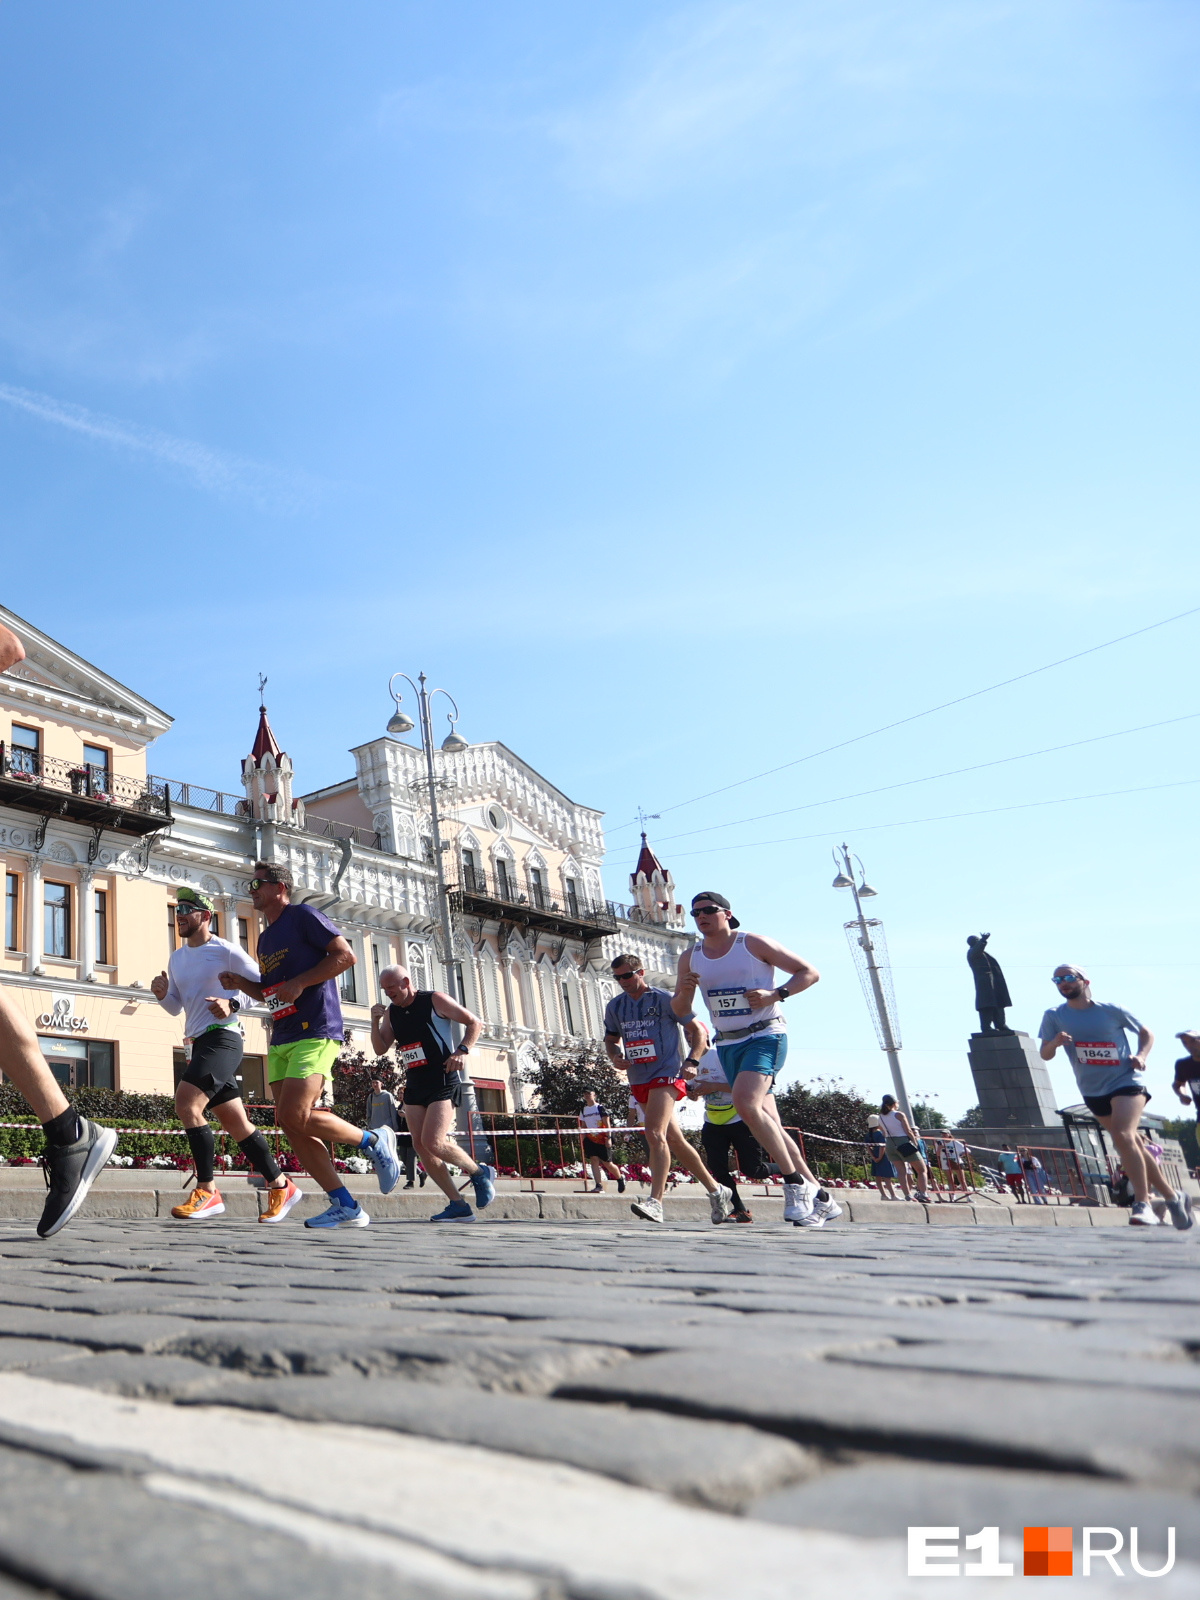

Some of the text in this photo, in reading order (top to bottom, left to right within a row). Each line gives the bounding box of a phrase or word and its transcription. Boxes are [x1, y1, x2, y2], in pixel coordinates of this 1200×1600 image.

[718, 998, 737, 1008] 157
[41, 1012, 90, 1030] OMEGA
[625, 1028, 649, 1039] ТРЕЙД
[403, 1051, 418, 1062] 1961
[629, 1047, 650, 1058] 2579
[1083, 1049, 1111, 1058] 1842
